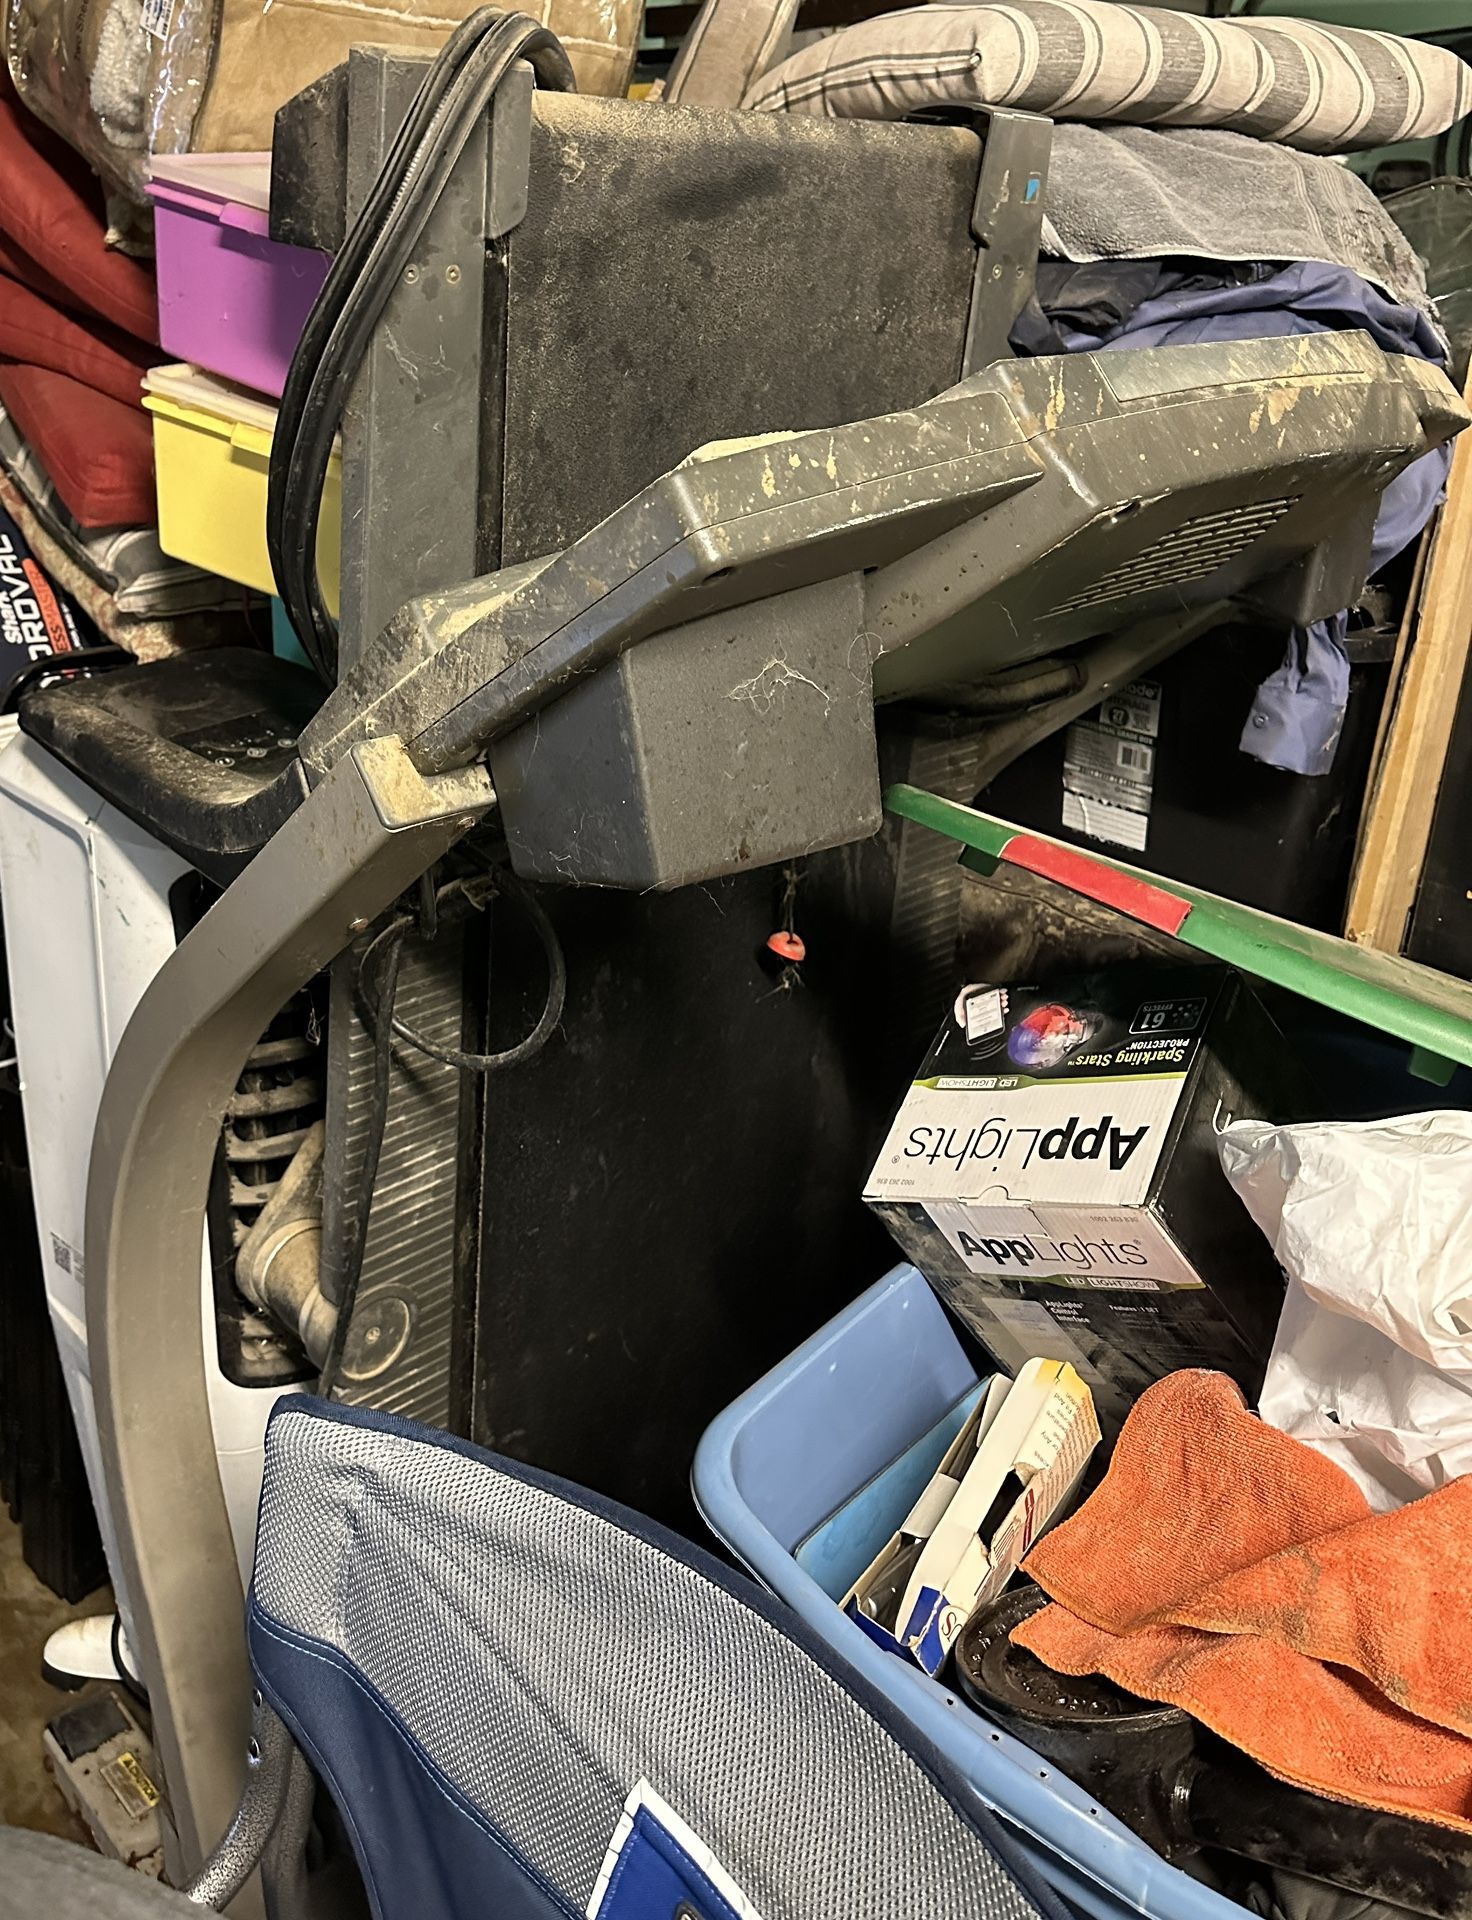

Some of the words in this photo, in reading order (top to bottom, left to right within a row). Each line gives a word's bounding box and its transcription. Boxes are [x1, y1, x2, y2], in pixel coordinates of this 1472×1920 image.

[1143, 1003, 1174, 1012] EFFECTS
[1141, 1012, 1166, 1029] 61
[1129, 1038, 1190, 1051] PROJECTION
[1115, 1047, 1185, 1066] Sparkling
[940, 1078, 996, 1088] LIGHTSHOW
[999, 1079, 1018, 1088] LED
[1090, 1279, 1158, 1290] LIGHTSHOW
[1051, 1307, 1079, 1316] Control
[1056, 1315, 1091, 1324] Interface
